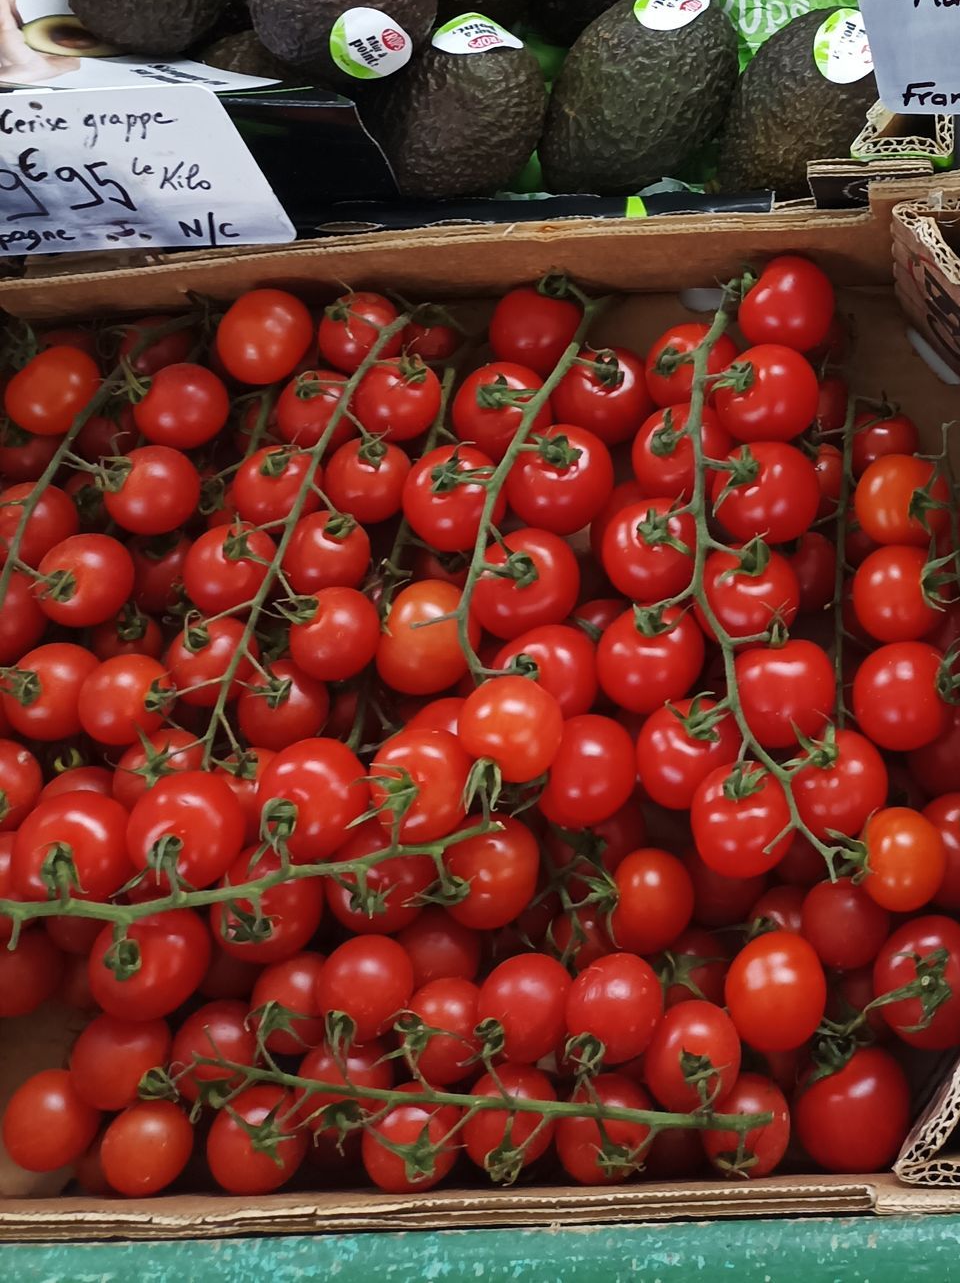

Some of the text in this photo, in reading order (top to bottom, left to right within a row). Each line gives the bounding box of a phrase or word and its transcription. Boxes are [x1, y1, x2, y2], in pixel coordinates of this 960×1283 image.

[83, 111, 179, 148] grappe
[131, 157, 155, 177] le
[158, 161, 212, 191] Kilo
[178, 211, 241, 247] N/C
